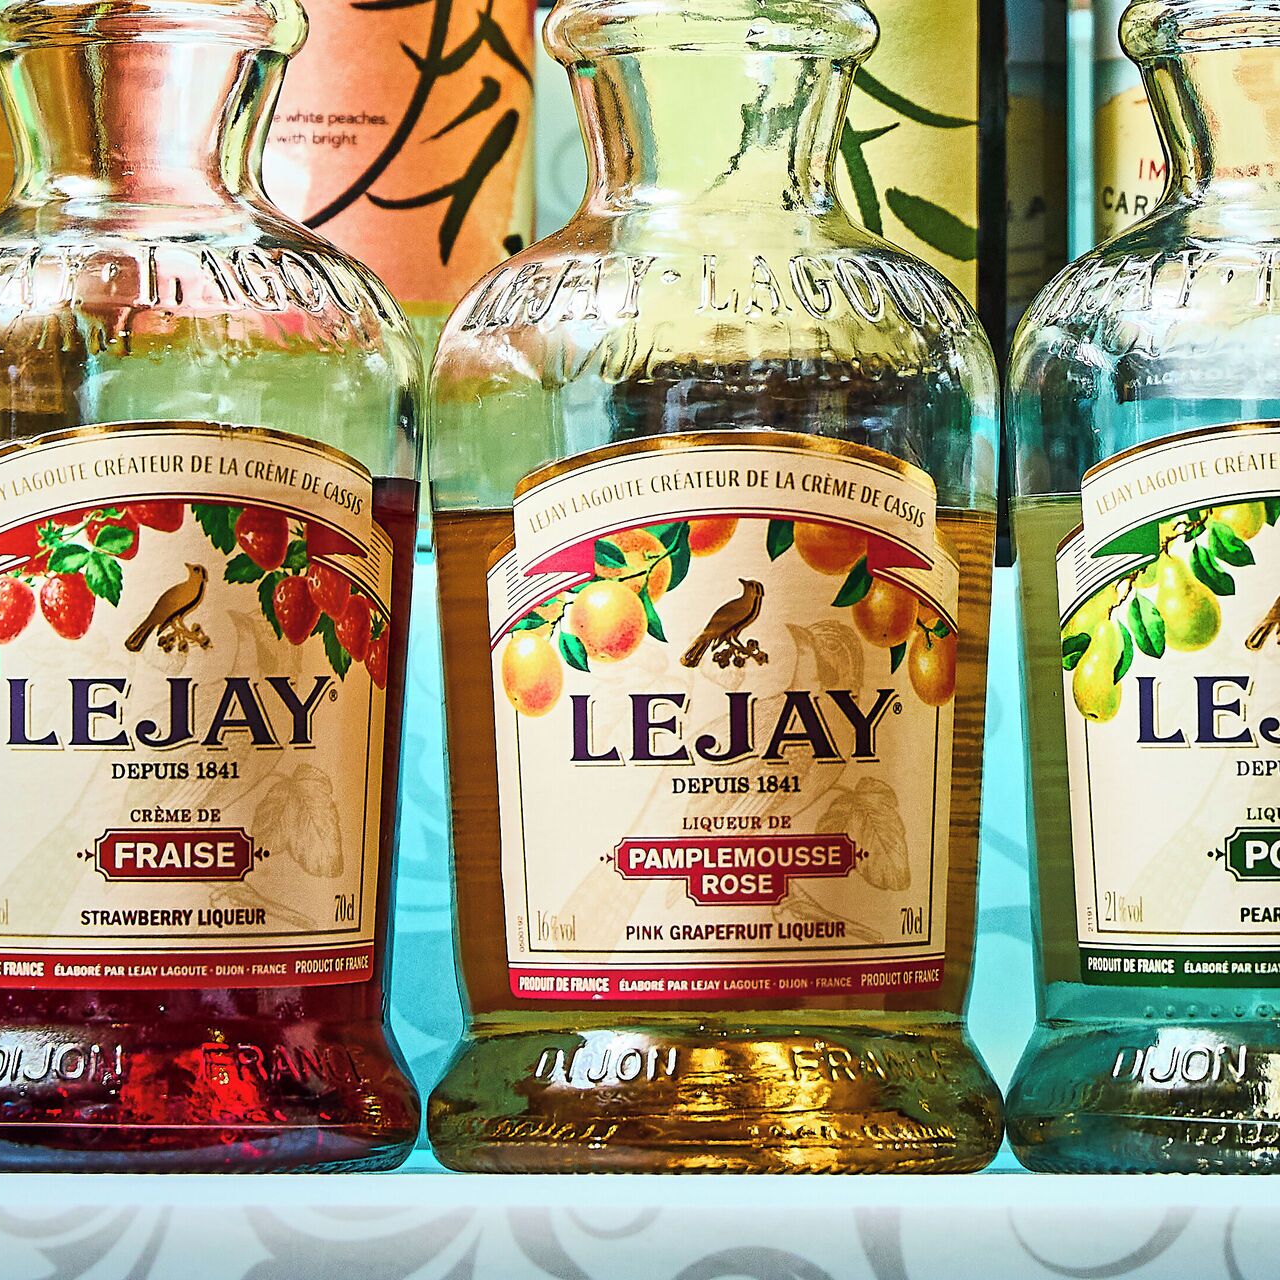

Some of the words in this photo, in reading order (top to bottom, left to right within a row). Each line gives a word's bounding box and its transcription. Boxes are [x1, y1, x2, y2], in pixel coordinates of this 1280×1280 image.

[286, 111, 324, 124] white
[328, 111, 388, 126] peaches.
[278, 134, 306, 143] with
[312, 131, 357, 148] bright
[528, 501, 570, 534] LEJAY
[571, 479, 645, 512] LAGOUTE
[651, 470, 740, 494] CRÉATEUR
[747, 470, 769, 489] DE
[776, 472, 795, 489] LA
[802, 475, 857, 503] CRÈME
[860, 486, 881, 508] DE
[883, 495, 927, 529] CASSIS
[7, 676, 332, 746] LEJAY
[570, 689, 895, 763] LEJAY
[112, 763, 189, 780] DEPUIS
[196, 762, 239, 779] 1841
[672, 777, 750, 795] DEPUIS
[757, 776, 801, 793] 1841
[130, 807, 191, 823] CRÈME
[197, 809, 221, 823] DE
[682, 816, 762, 831] LIQUEUR
[769, 815, 791, 830] DE
[114, 842, 236, 869] FRAISE
[628, 847, 842, 869] PAMPLEMOUSSE
[701, 874, 773, 895] ROSE
[80, 908, 193, 928] STRAWBERRY
[198, 909, 266, 927] LIQUEUR
[626, 925, 664, 940] PINK
[670, 923, 772, 940] GRAPEFRUIT
[778, 923, 846, 939] LIQUEUR
[1184, 959, 1229, 974] ÉLABORÉ
[1232, 961, 1251, 974] PAR
